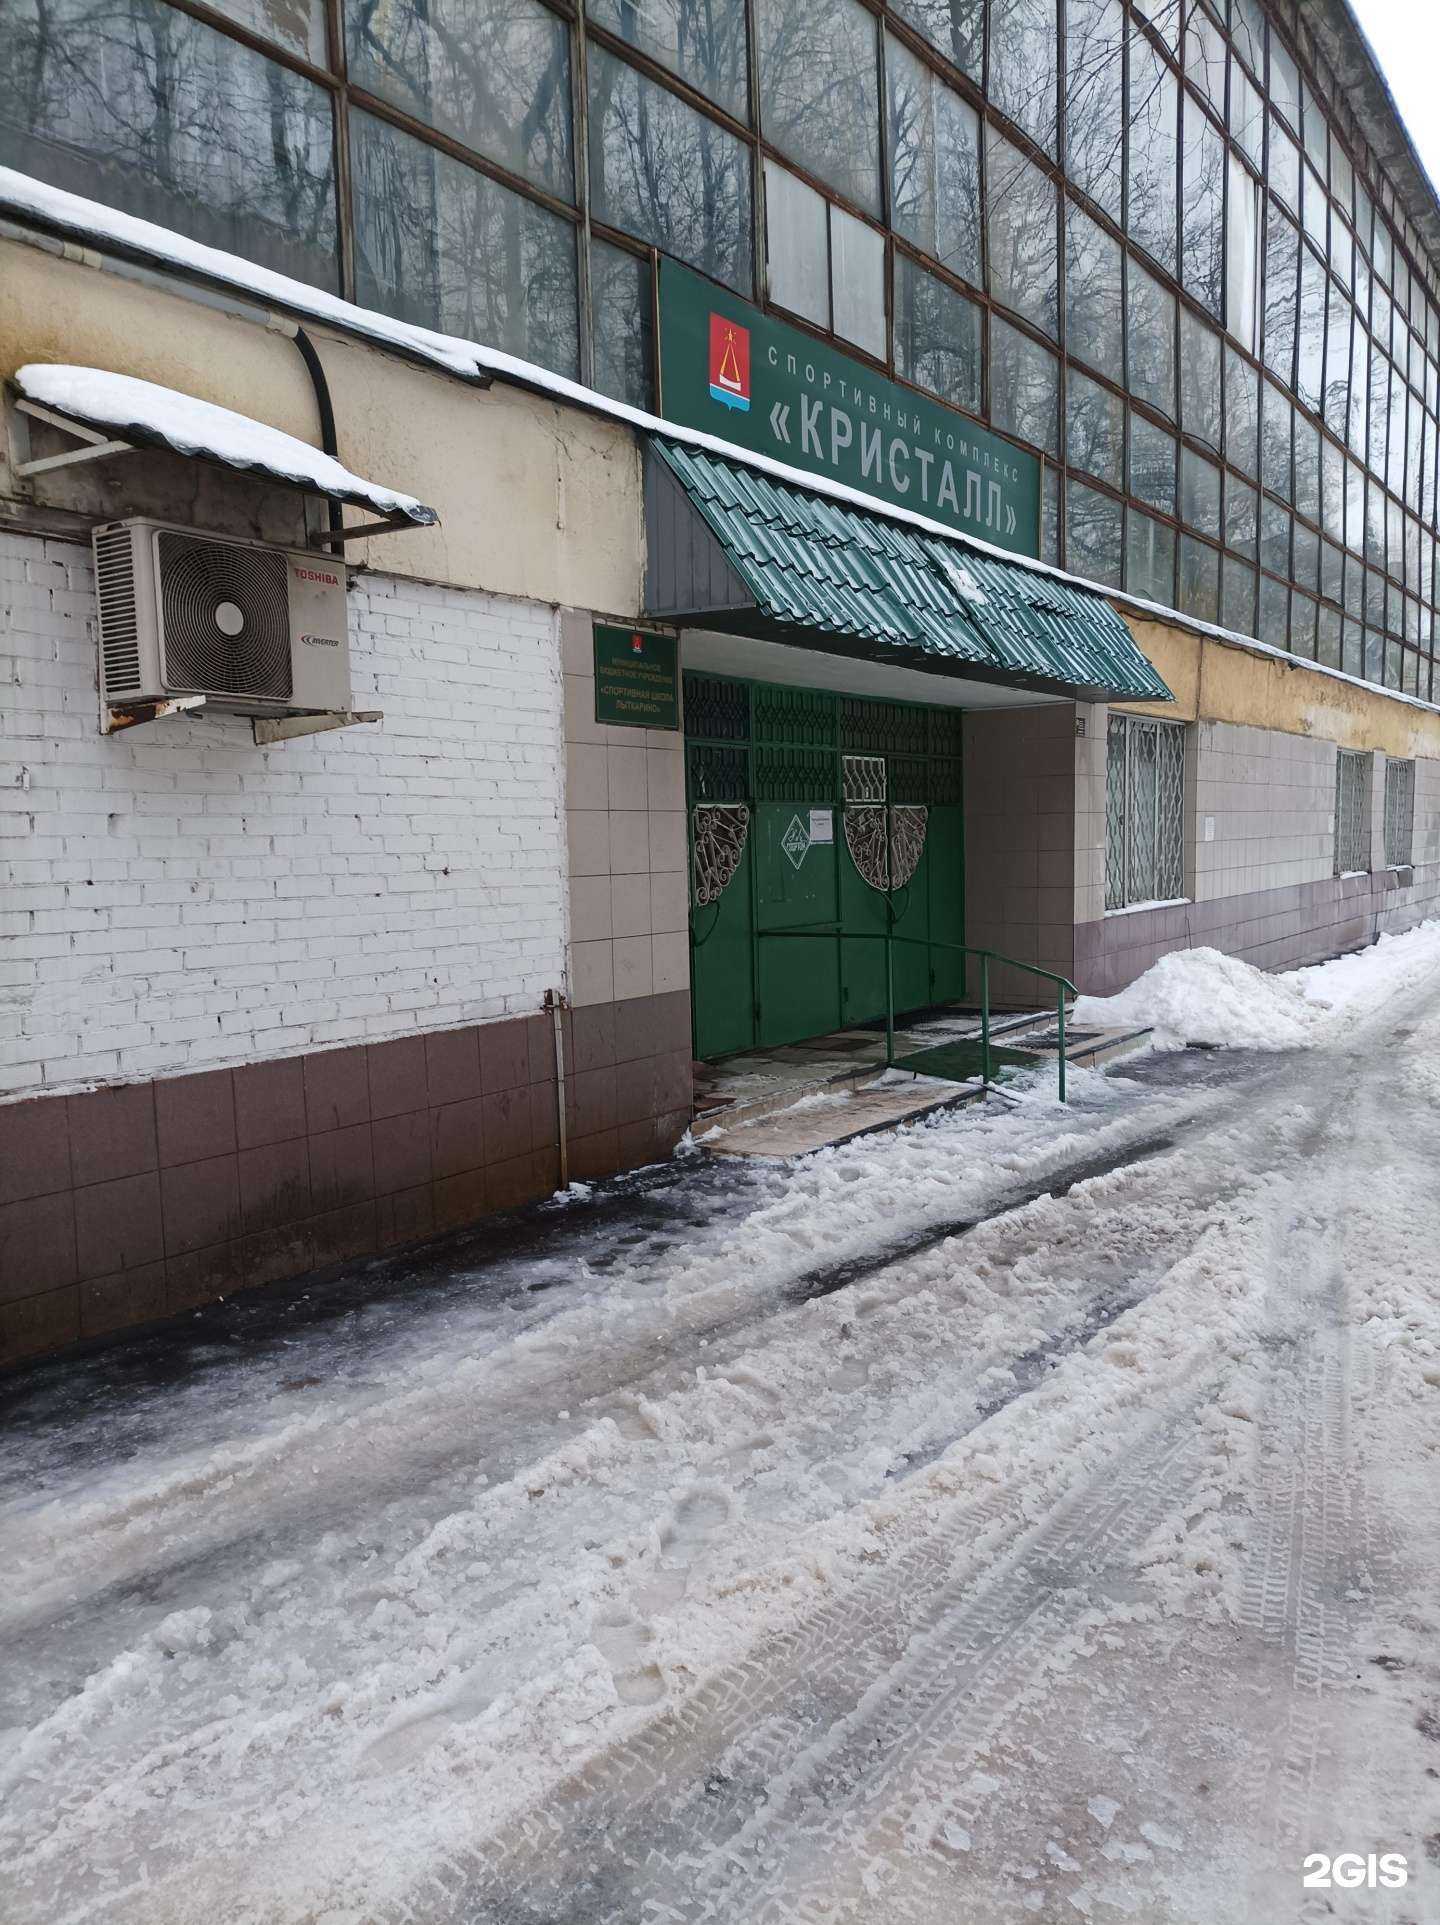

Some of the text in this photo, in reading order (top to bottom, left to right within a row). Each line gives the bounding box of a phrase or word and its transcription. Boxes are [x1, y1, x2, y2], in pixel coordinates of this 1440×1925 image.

[768, 346, 1019, 482] СПОРТИВНЫЙ КОМПЛЕКС
[769, 393, 1017, 535] «КРИСТАЛЛ»
[294, 568, 339, 585] TOSHIBA
[312, 638, 339, 647] INVERTER
